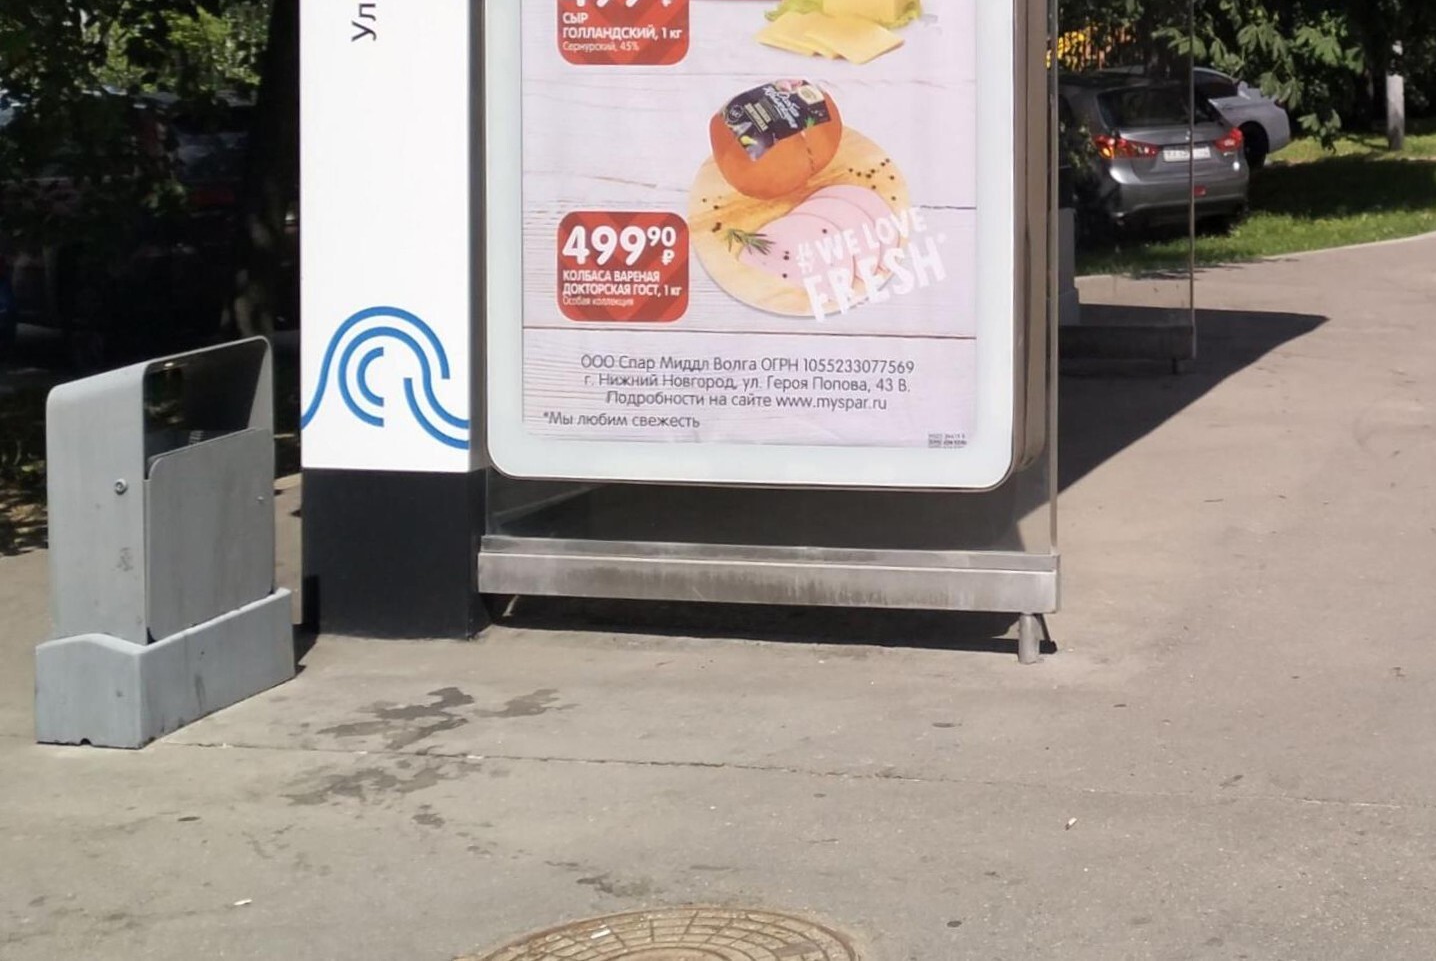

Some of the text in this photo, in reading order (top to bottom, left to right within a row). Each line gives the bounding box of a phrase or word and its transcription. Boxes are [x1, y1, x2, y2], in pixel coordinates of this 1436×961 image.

[562, 12, 588, 24] СЫР
[563, 25, 682, 40] ГОЛЛАНДСКИЙ, 1 кг
[620, 41, 640, 51] 45%
[862, 207, 927, 249] LOVE
[563, 270, 660, 282] КОЛБАСА ВАРЕНАЯ
[562, 283, 682, 297] ДОКТОРСКАЯ ГОСТ, 1 кг
[581, 354, 915, 374] ООО Спар Миддл Волга ОГРН 1055233077569
[584, 373, 911, 393] г. Нижний Новгород, ул. Героя Попова, 43 В.
[606, 390, 887, 411] Подробности на сайте www.myspar.ru
[577, 413, 628, 426] любим
[632, 416, 700, 428] свежесть
